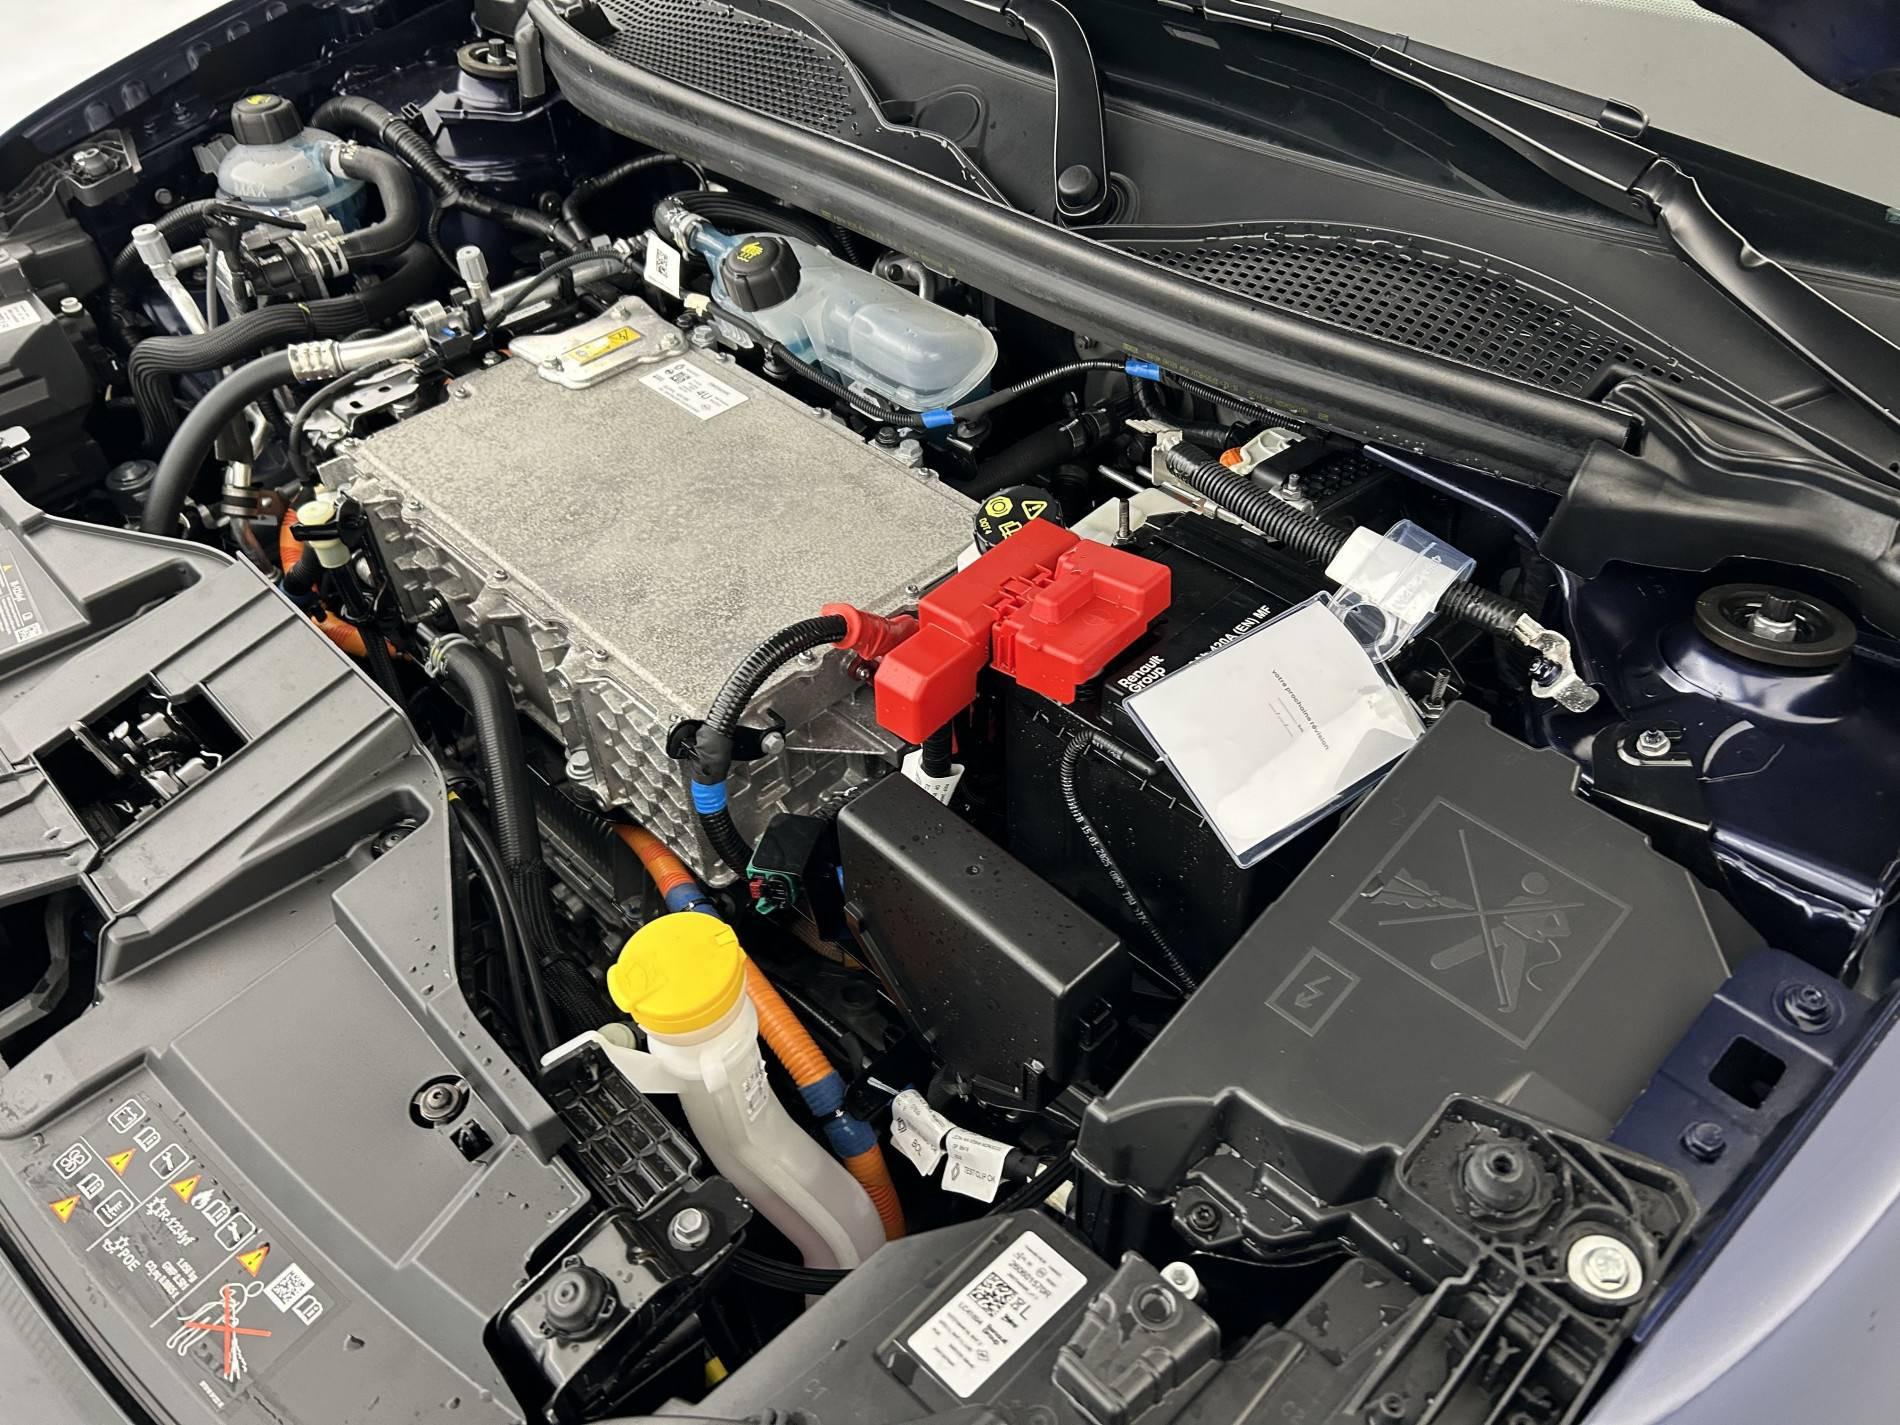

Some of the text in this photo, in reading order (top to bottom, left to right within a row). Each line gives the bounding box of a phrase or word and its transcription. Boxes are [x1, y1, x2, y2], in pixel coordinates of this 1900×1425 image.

[979, 518, 991, 530] DOT
[1233, 617, 1259, 635] (EN)
[1253, 605, 1272, 619] MF
[1118, 655, 1165, 689] Renault
[1128, 667, 1166, 693] Group
[1272, 669, 1287, 687] votre
[1285, 687, 1312, 721] prochaine
[1310, 721, 1329, 750] révision
[1080, 824, 1111, 868] 15.01.2025
[158, 1208, 195, 1246] R-1234yf
[117, 1248, 141, 1272] POE
